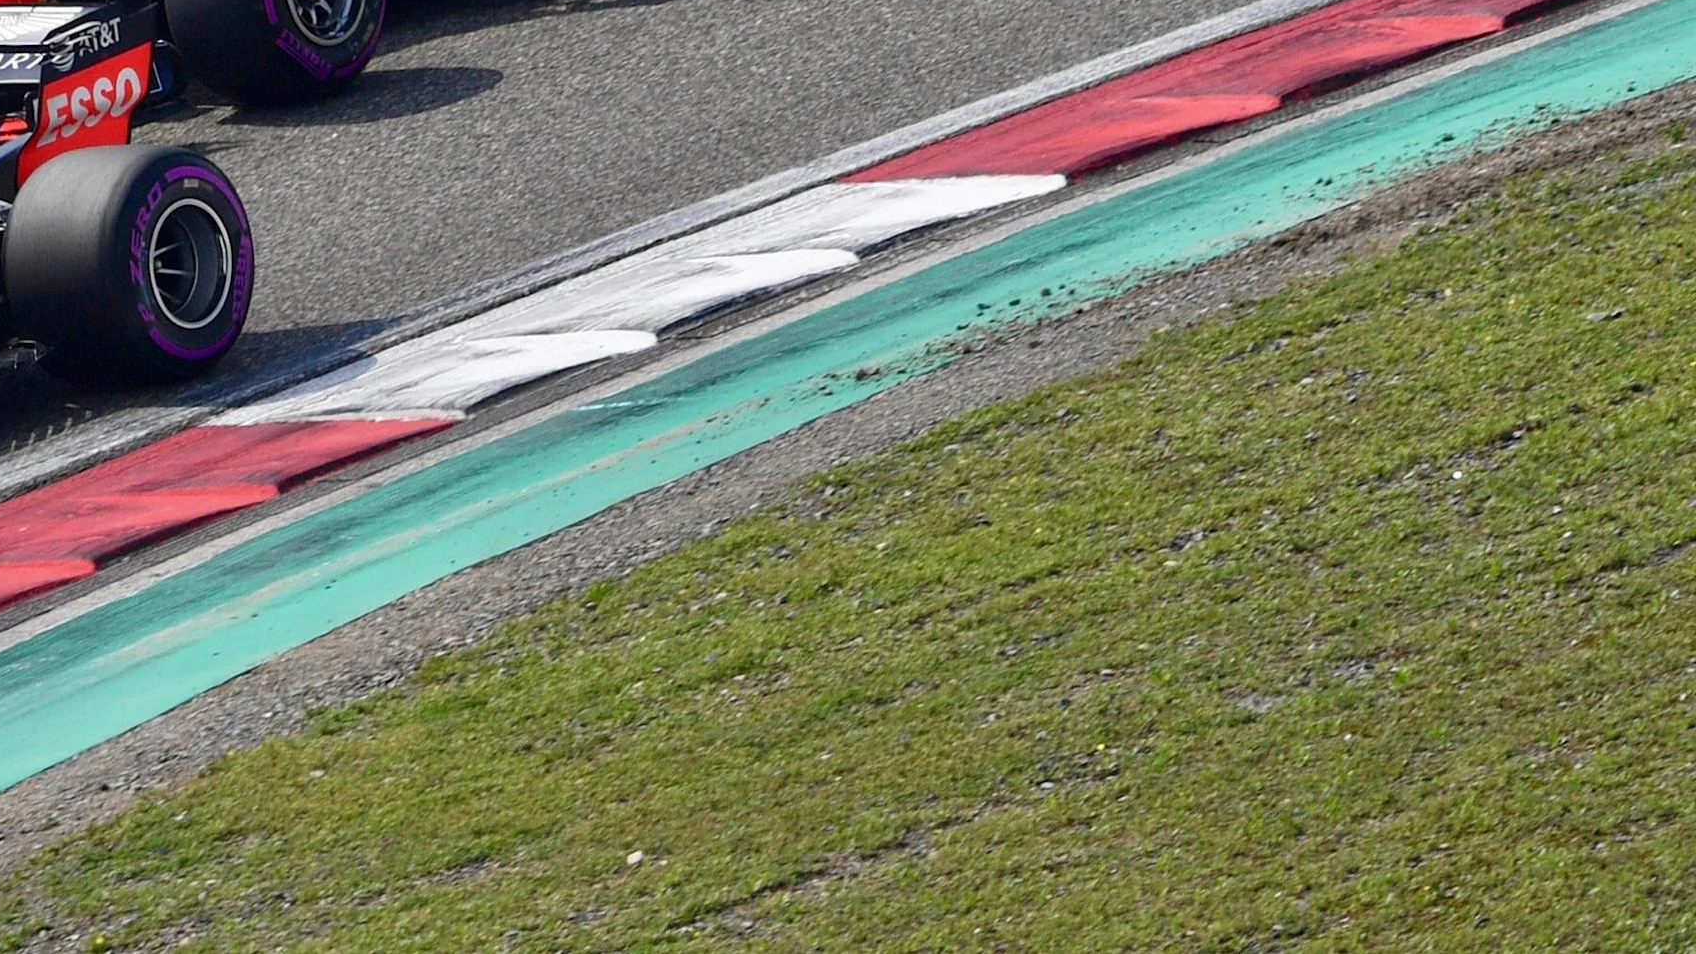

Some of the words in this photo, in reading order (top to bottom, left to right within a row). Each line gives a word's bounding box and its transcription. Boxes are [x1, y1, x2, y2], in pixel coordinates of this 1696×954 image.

[79, 17, 123, 56] AT&T
[37, 68, 141, 147] ESSO
[130, 181, 163, 286] ZERO
